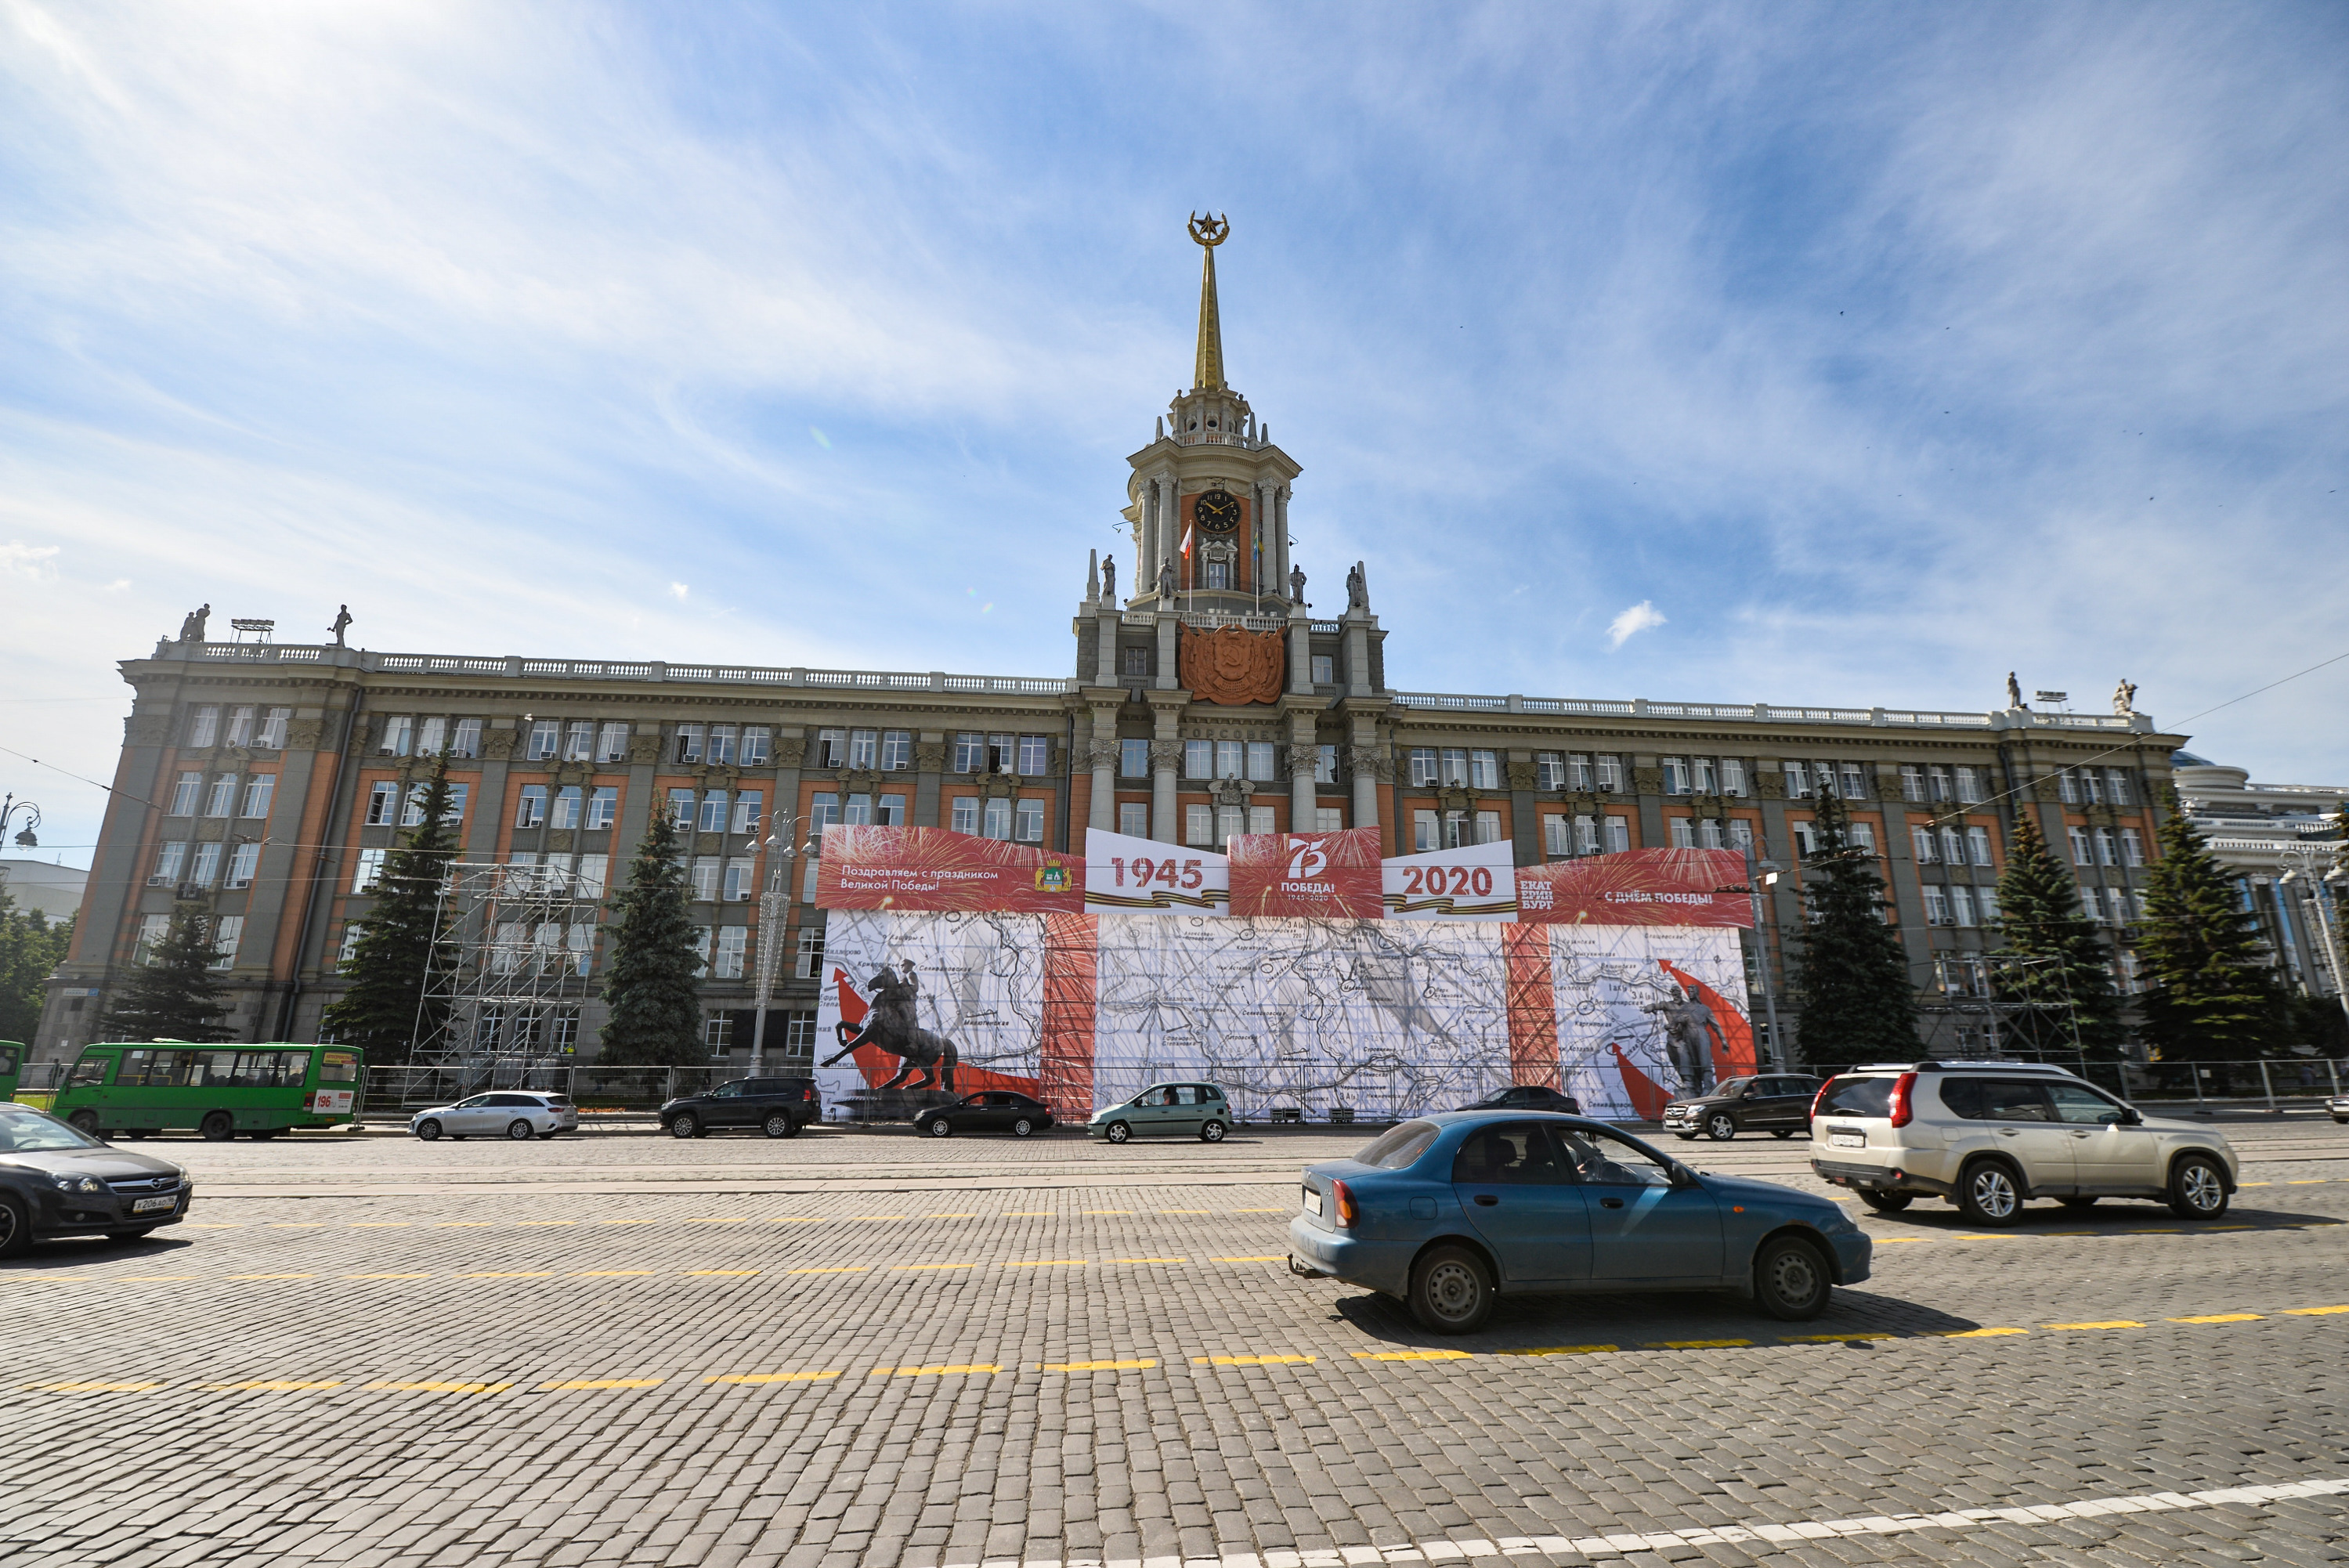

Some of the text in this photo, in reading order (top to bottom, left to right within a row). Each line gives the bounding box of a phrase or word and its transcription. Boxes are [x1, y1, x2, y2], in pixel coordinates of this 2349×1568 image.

[842, 865, 917, 879] Поздравляем
[931, 870, 998, 880] праздником
[1111, 857, 1203, 889] 1945
[840, 878, 939, 891] Великой Победы!
[1402, 865, 1493, 896] 2020
[1520, 880, 1552, 891] ЕКАТ
[1281, 882, 1335, 894] ПОБЕДА!
[1521, 890, 1553, 901] ЕРИН
[1605, 890, 1712, 905] С ДНЁМ ПОБЕДЫ!
[1522, 900, 1554, 909] БУРГ
